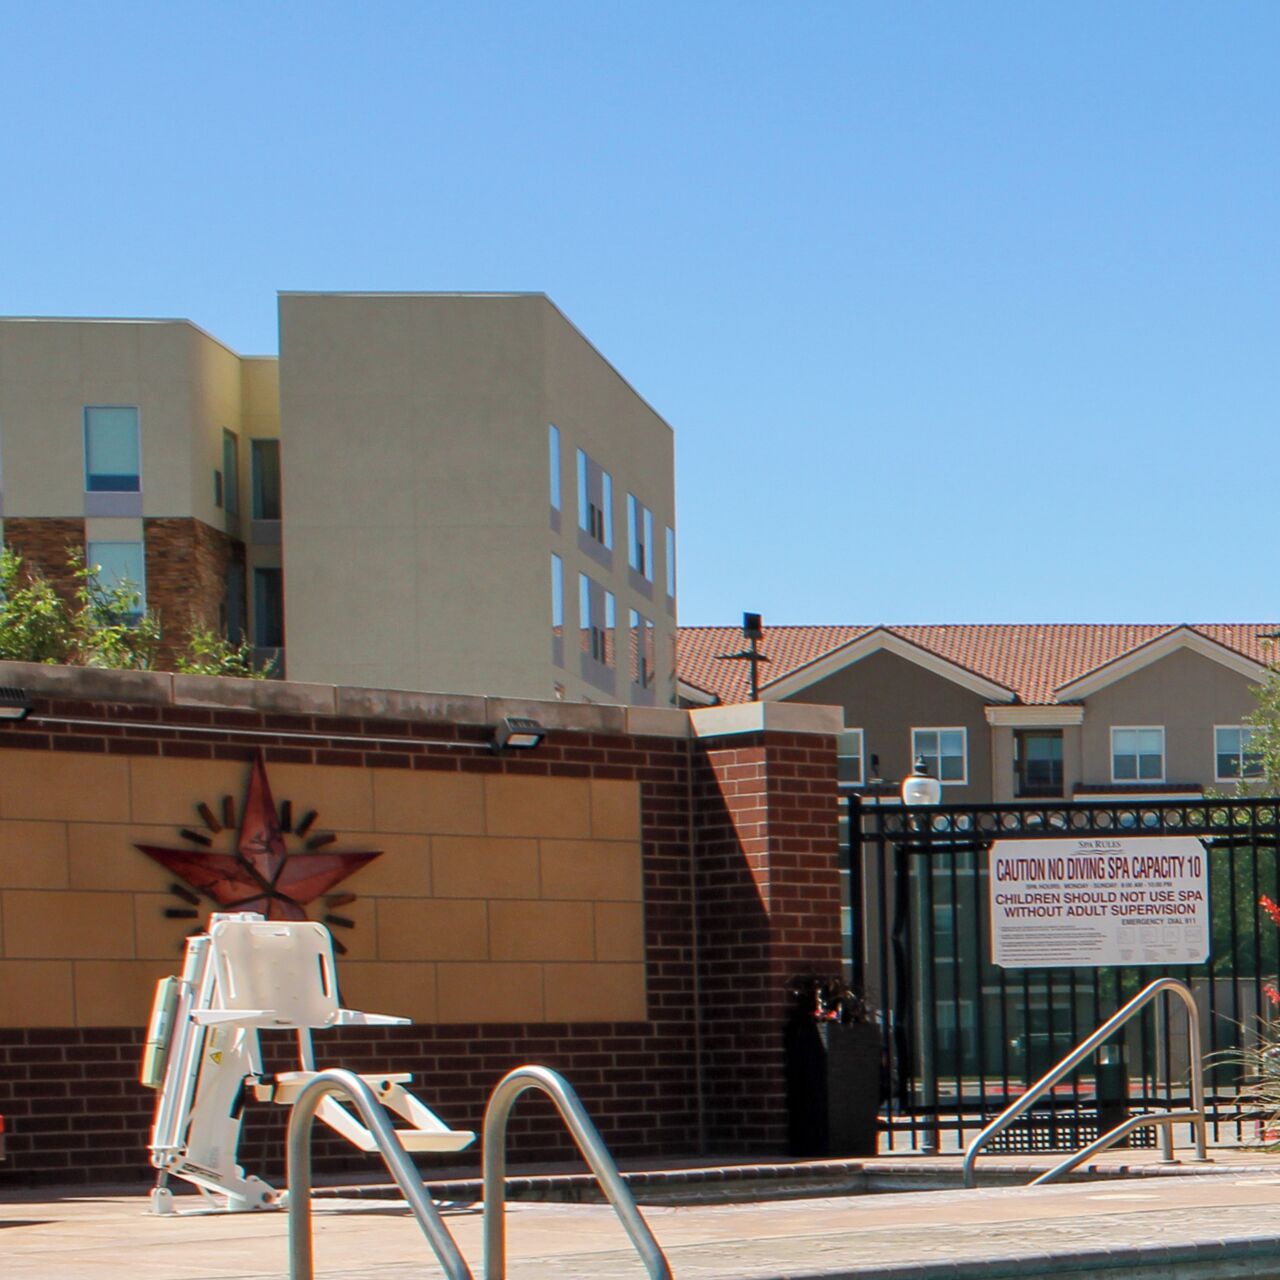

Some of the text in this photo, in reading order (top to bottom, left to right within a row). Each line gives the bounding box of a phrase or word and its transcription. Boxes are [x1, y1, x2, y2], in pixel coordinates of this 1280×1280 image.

[997, 855, 1201, 881] CAUTION NO DIVING SPA CAPACITY 10
[995, 890, 1203, 905] CHILDREN SHOULD NOT USE SPA
[1005, 904, 1196, 918] WITHOUT ADULT SUPERVISION
[1121, 918, 1164, 926] EMERGENCY
